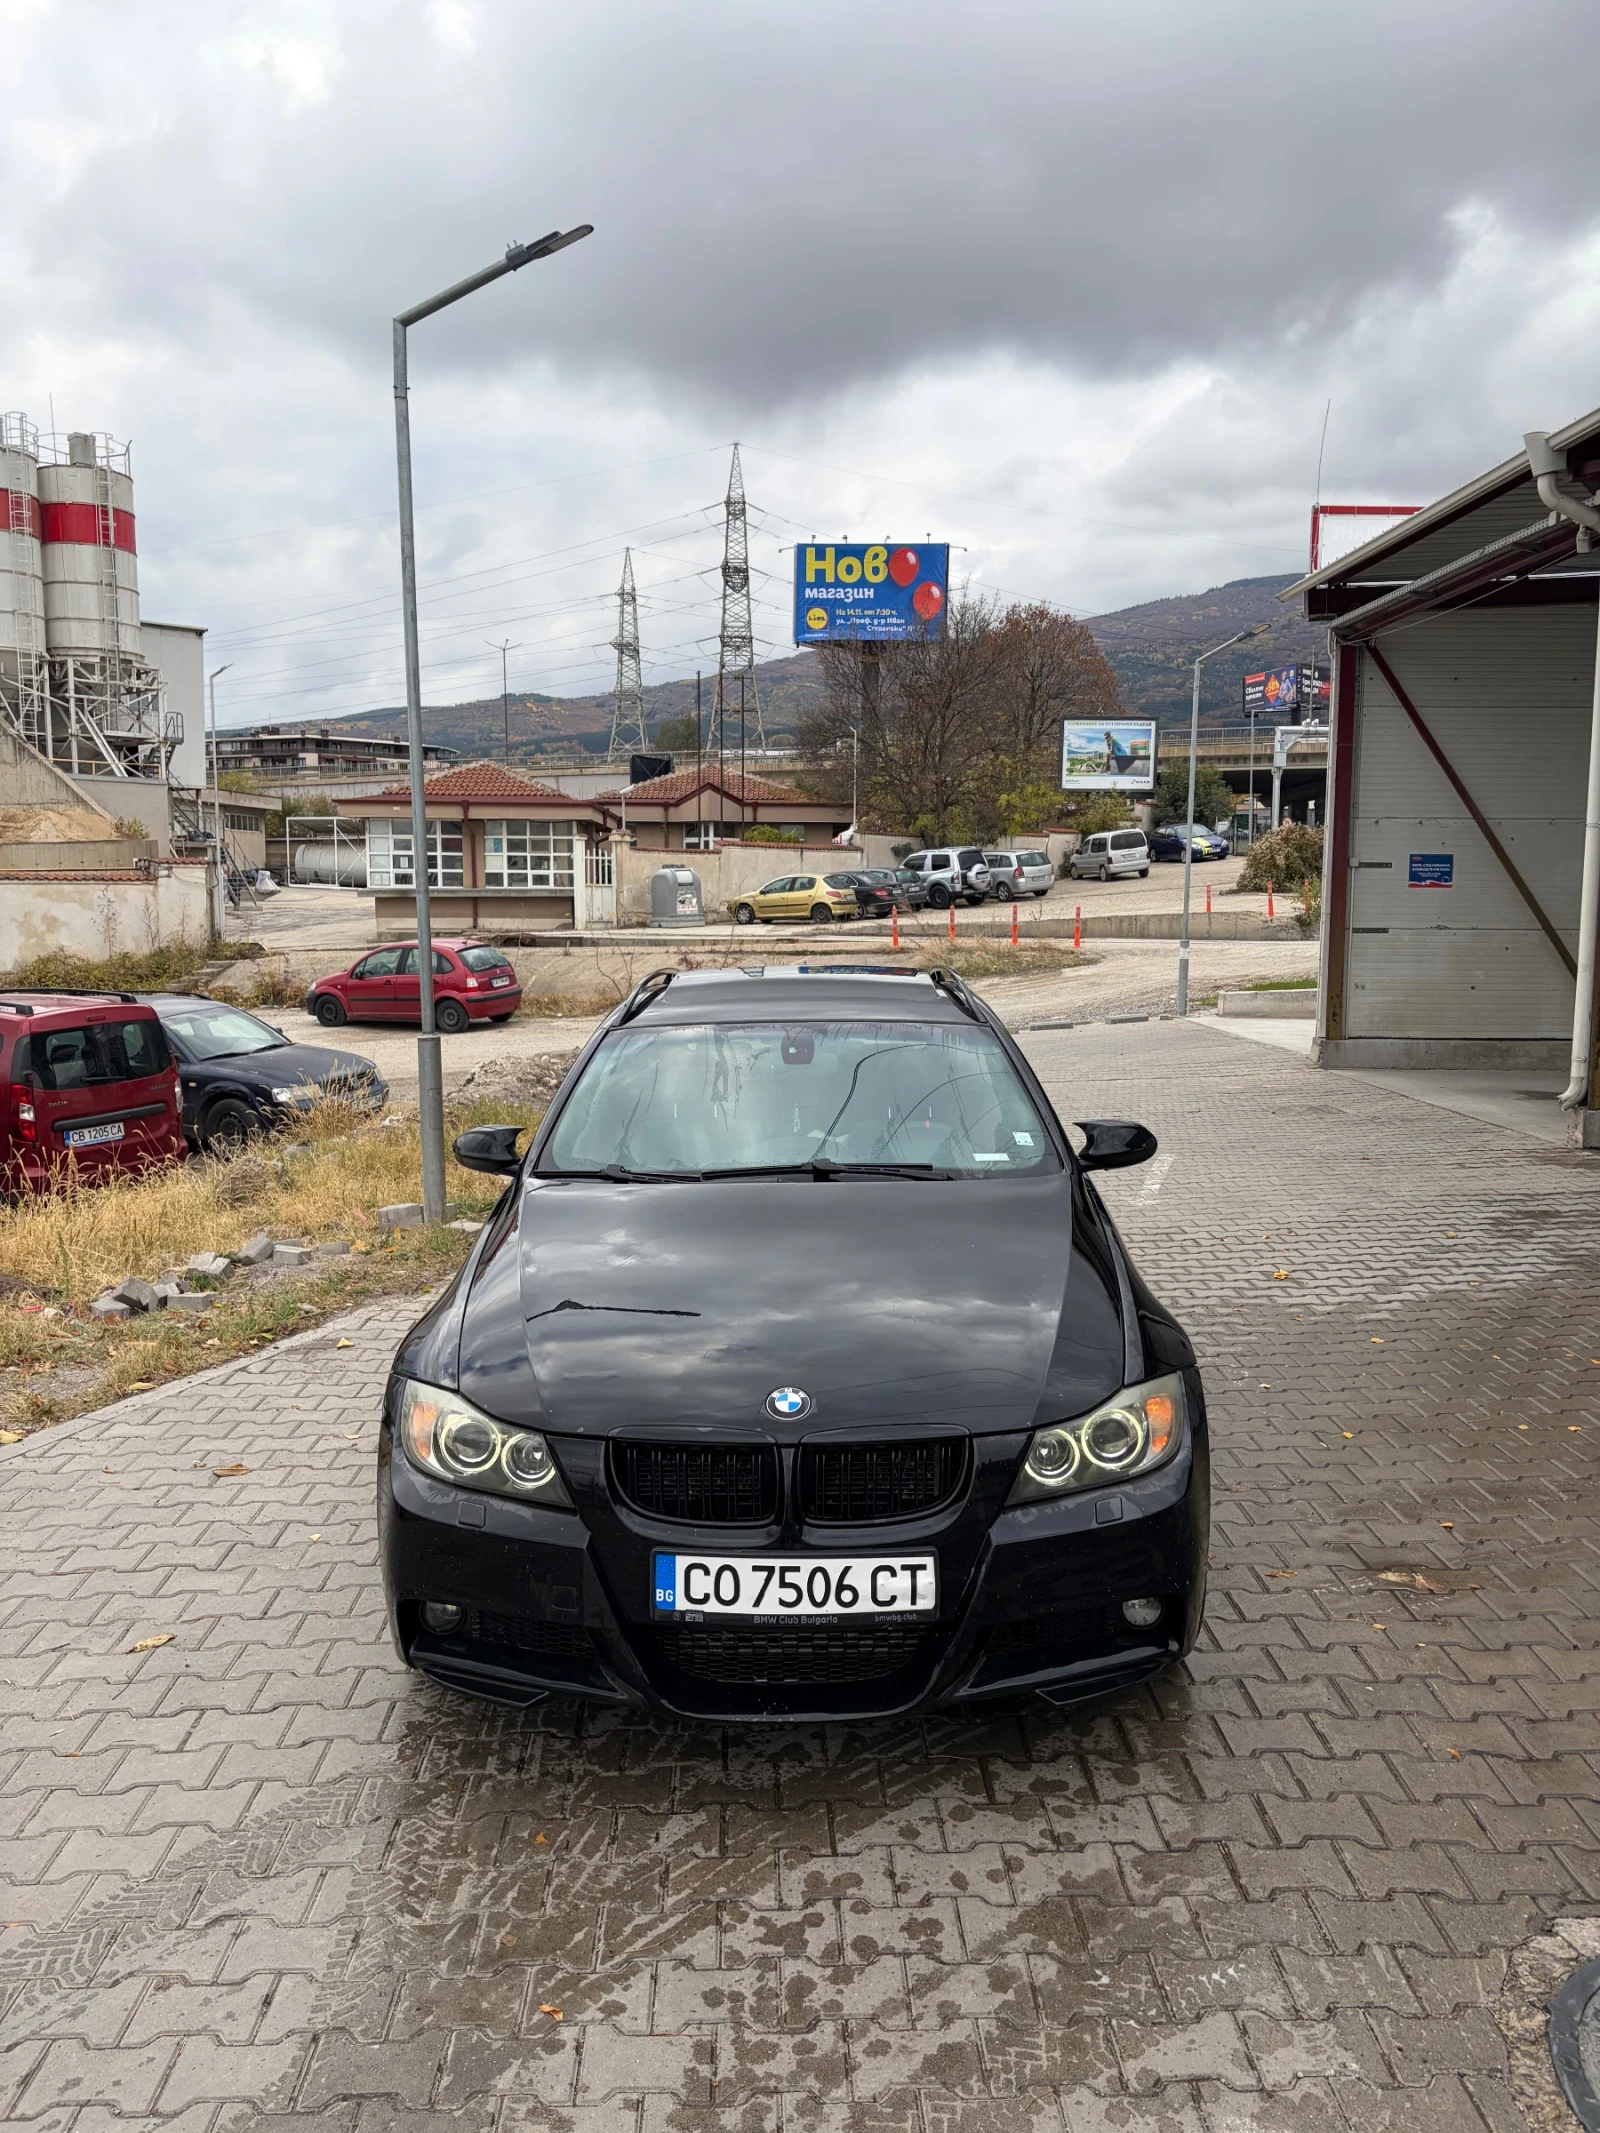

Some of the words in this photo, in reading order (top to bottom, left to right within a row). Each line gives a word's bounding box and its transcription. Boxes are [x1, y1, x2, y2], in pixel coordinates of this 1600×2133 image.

[806, 546, 888, 583] Нов
[805, 588, 874, 603] магазин
[71, 1130, 86, 1143] CB
[88, 1126, 109, 1140] 1205
[110, 1125, 123, 1136] CA
[684, 1563, 740, 1606] CO
[752, 1564, 860, 1608] 7506
[871, 1564, 927, 1607] CT
[656, 1589, 674, 1601] BG
[754, 1615, 777, 1624] BMW
[779, 1615, 799, 1625] Club
[801, 1615, 838, 1626] Bulgaria
[874, 1613, 918, 1623] bmwbg.club
